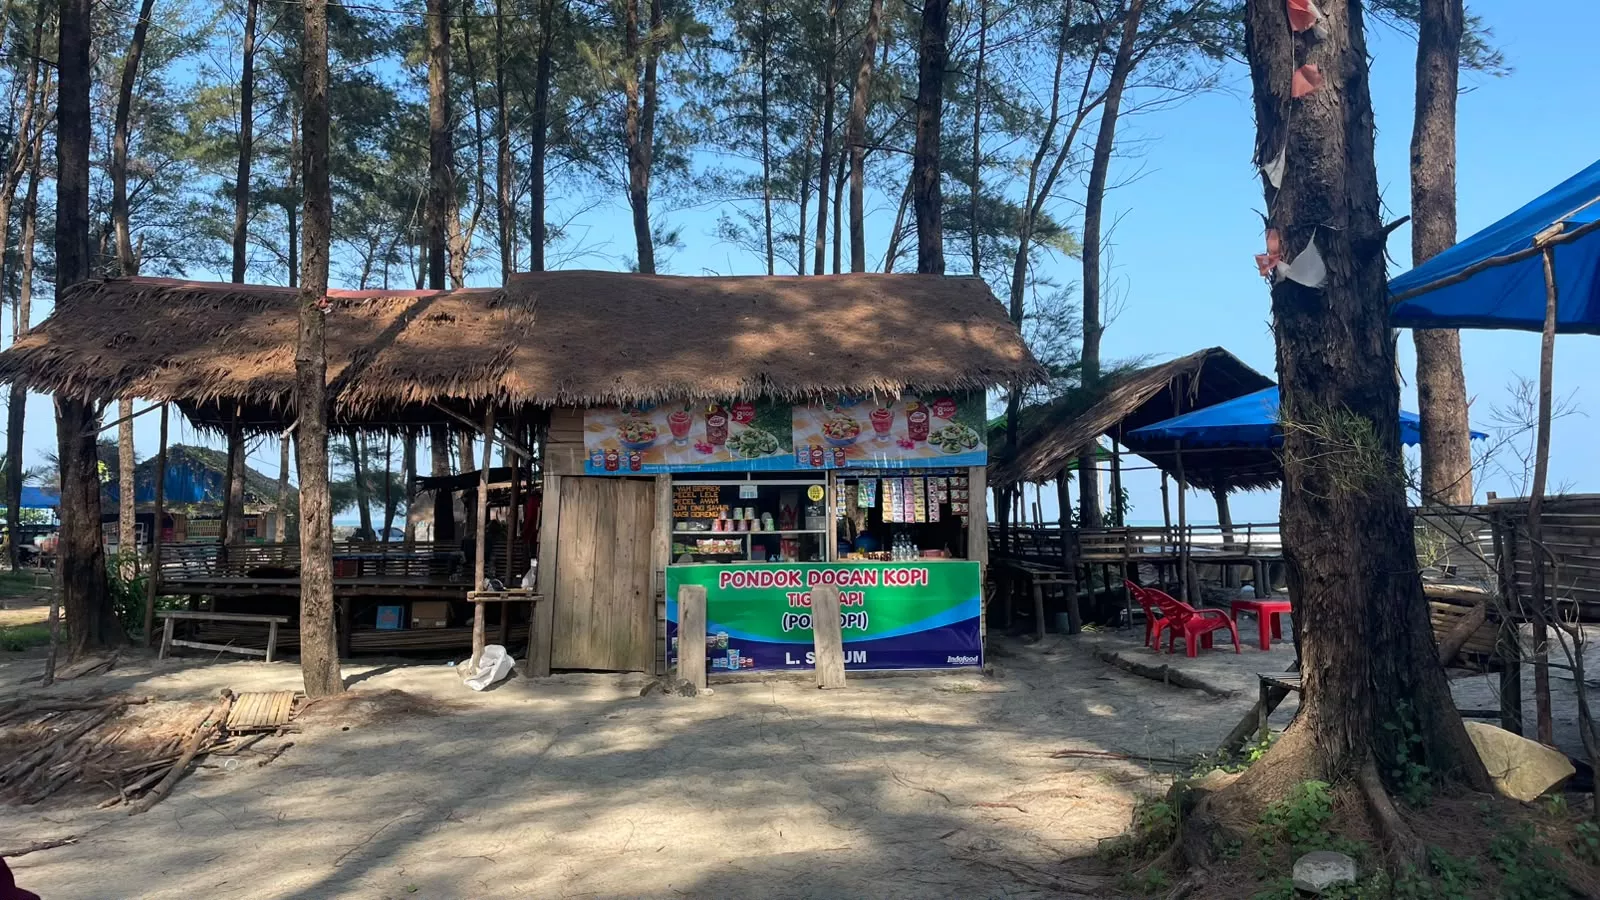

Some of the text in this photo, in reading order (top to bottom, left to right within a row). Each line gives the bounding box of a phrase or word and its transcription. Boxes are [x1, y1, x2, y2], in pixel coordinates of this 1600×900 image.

[720, 568, 929, 589] PONDOK DOGAN KOPI
[785, 651, 800, 665] L.
[947, 655, 979, 665] Indofood
